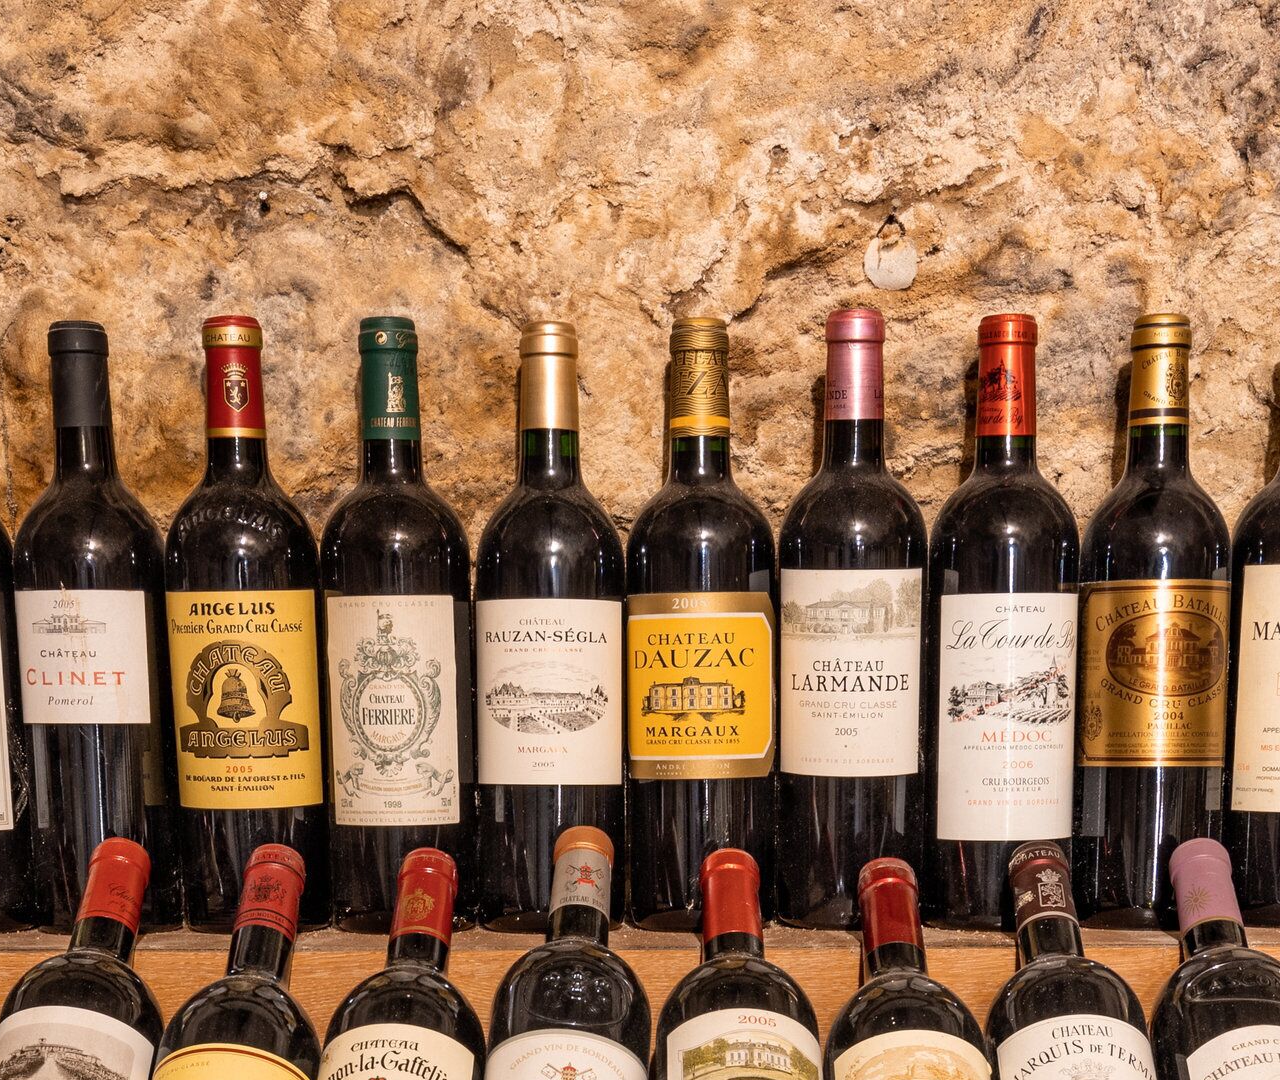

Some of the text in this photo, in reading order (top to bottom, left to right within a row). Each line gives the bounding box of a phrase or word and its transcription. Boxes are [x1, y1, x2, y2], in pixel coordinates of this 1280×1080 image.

[53, 600, 74, 609] 2005
[189, 602, 275, 615] ANGELUS
[996, 605, 1045, 613] CHÂTEAU
[207, 620, 244, 634] GRAND
[246, 620, 269, 633] CRU
[270, 620, 303, 633] CLASSÉ
[519, 617, 565, 626] CHÂTEAU
[485, 628, 607, 644] RAUZAN-SÉGLA
[648, 633, 735, 645] CHATEAU
[946, 619, 1055, 650] La Tour de
[40, 649, 97, 658] CHÂTEAU
[634, 648, 754, 668] DAUZAC
[192, 644, 285, 695] CHATEAU
[813, 658, 884, 672] CHÂTEAU
[27, 669, 125, 686] CLINET
[792, 674, 909, 692] LARMANDE
[48, 696, 94, 706] Pomerol
[369, 694, 405, 704] CHATEAU
[362, 707, 416, 726] FERRIERE
[811, 711, 883, 719] SAINT-ÉMILION
[1154, 712, 1183, 720] 2004
[646, 727, 738, 737] MARGAUX
[835, 727, 858, 736] 2005
[981, 729, 1052, 742] MÉDOC
[188, 729, 297, 747] ANGELUS
[226, 765, 253, 773] 2005
[1002, 761, 1033, 769] 2006
[982, 777, 1049, 786] CRU BOURGEOIS
[738, 1015, 776, 1027] 2005
[1052, 1025, 1113, 1039] CHATEAU
[351, 1039, 419, 1052] CHATEAU
[1090, 1043, 1103, 1054] DE
